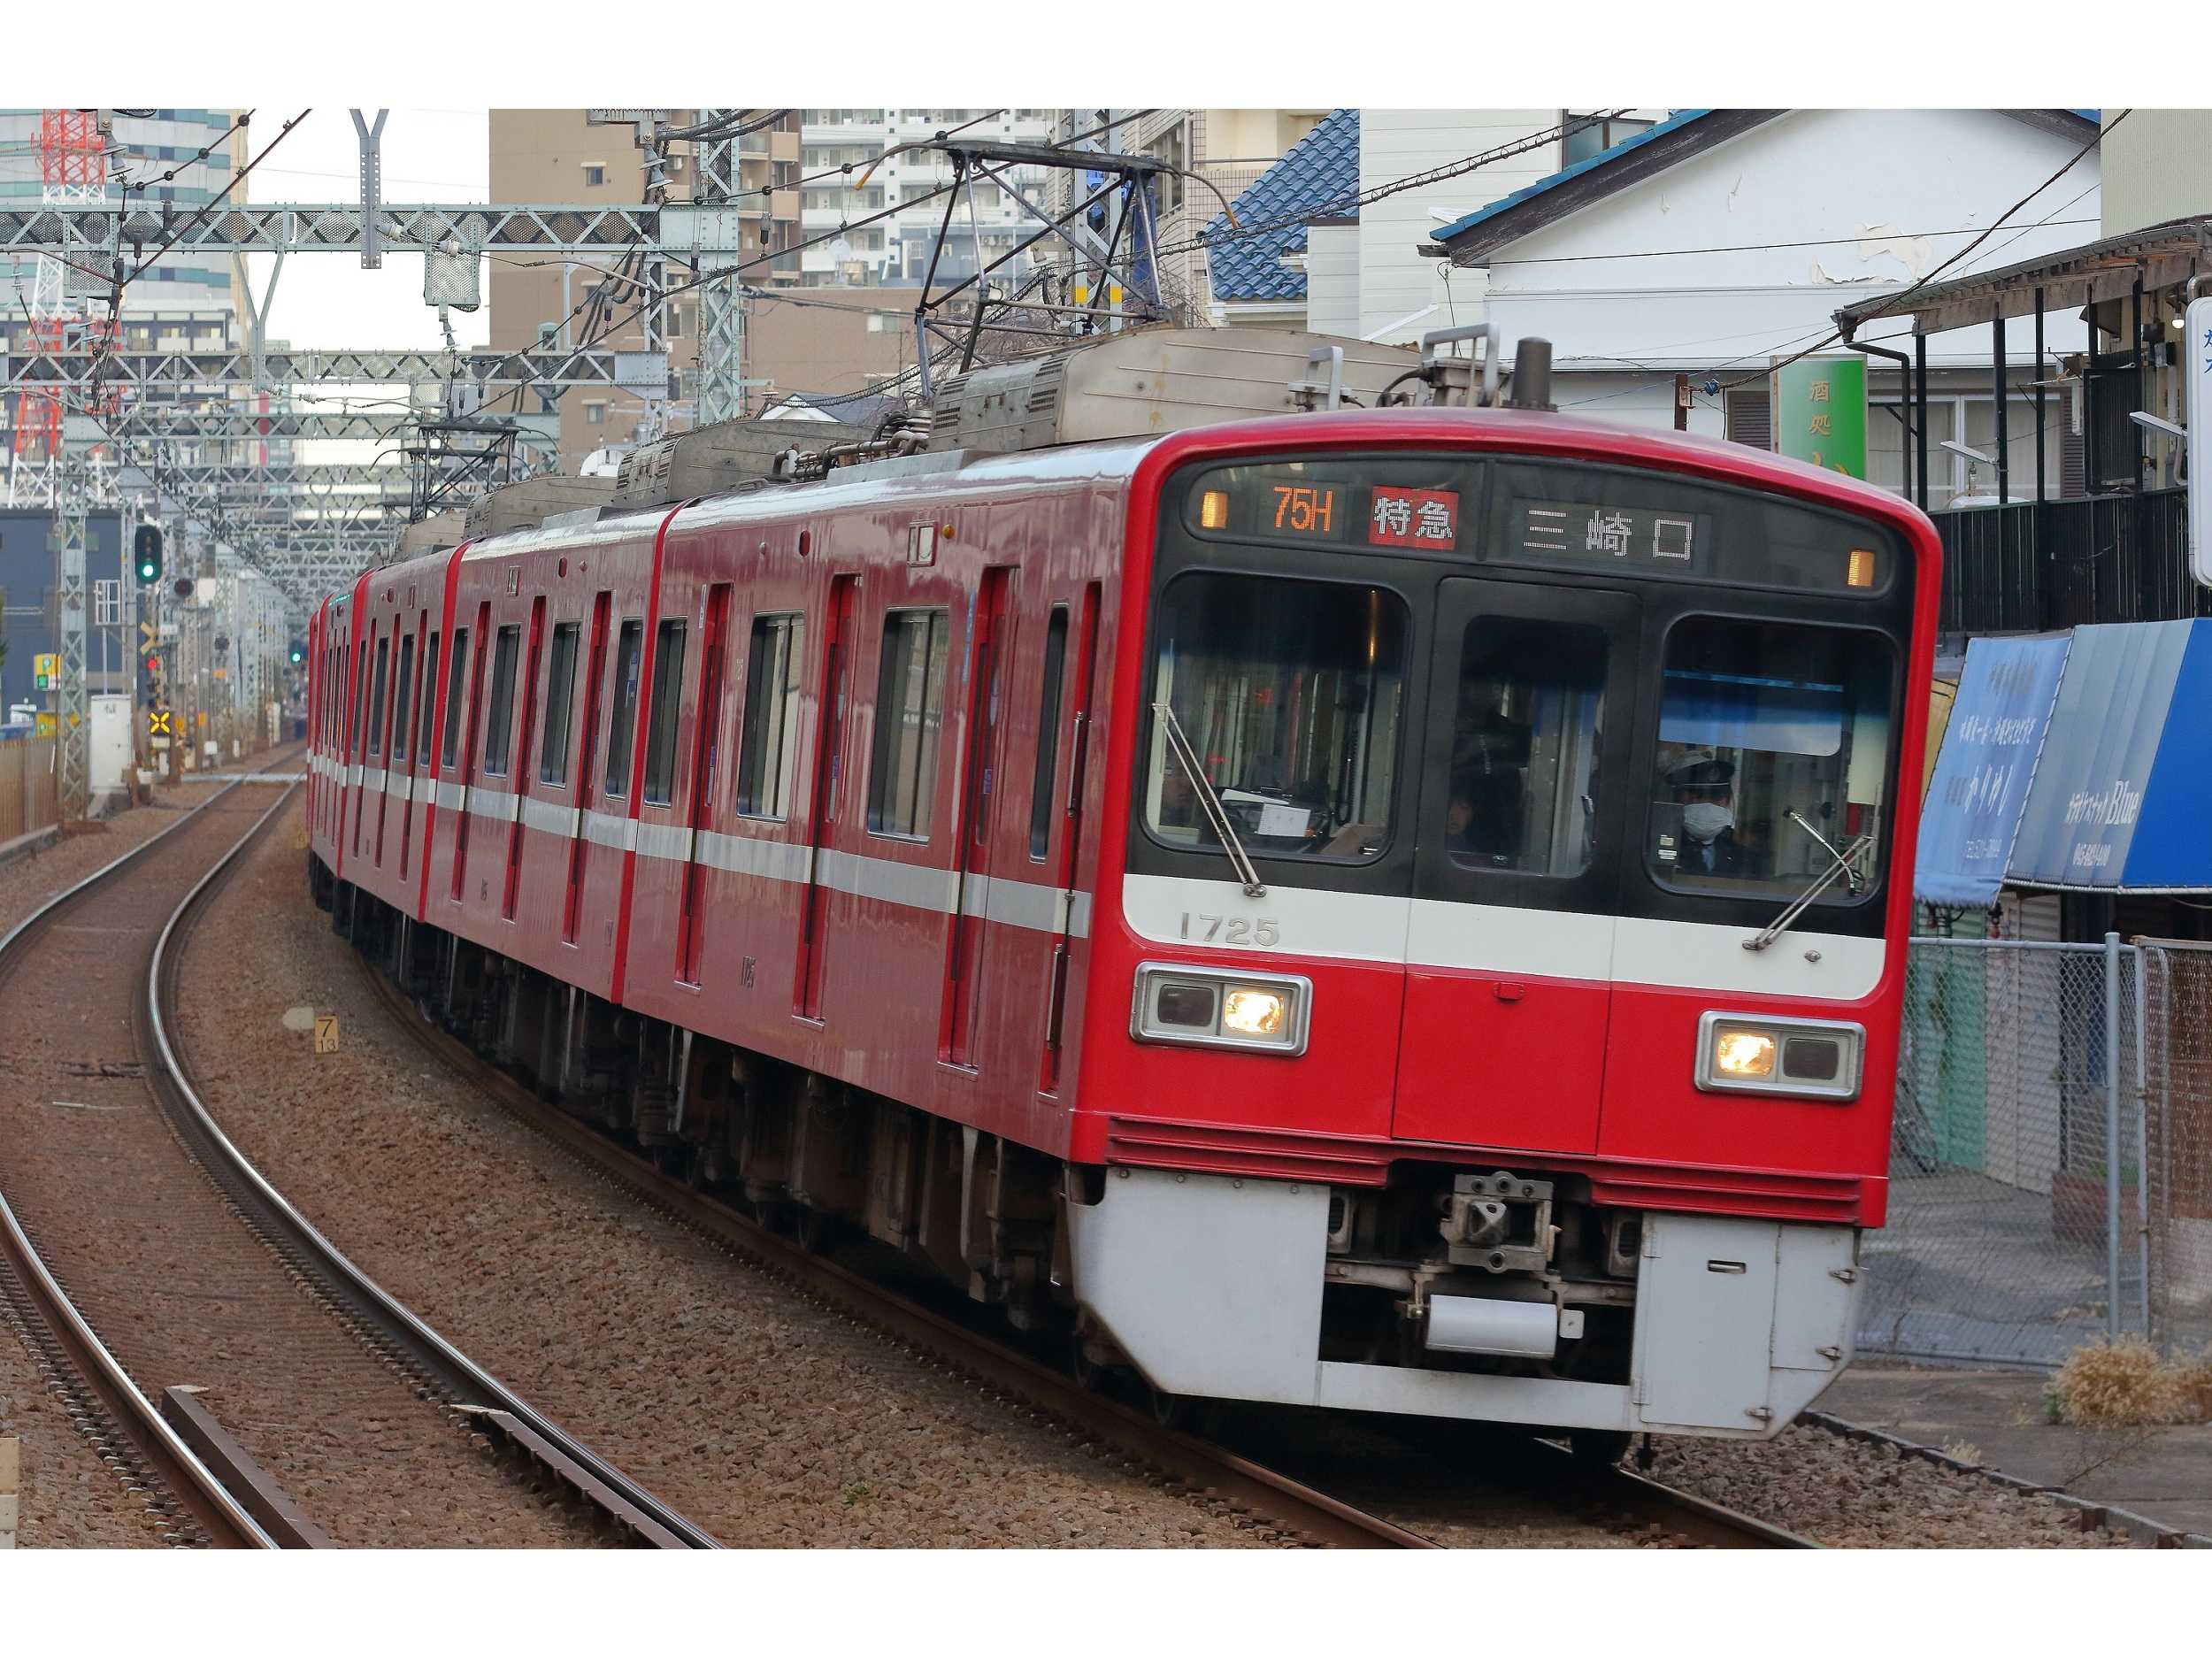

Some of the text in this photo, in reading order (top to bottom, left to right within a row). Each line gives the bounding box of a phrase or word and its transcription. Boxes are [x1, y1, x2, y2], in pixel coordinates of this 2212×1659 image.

[1809, 380, 1832, 437] 酒処
[1273, 487, 1333, 531] 75H
[1374, 497, 1453, 539] 特急
[1524, 510, 1692, 559] 三崎口
[2105, 780, 2139, 826] Blue
[1181, 912, 1279, 947] 1725
[318, 1018, 334, 1038] 7
[320, 1039, 336, 1051] 13
